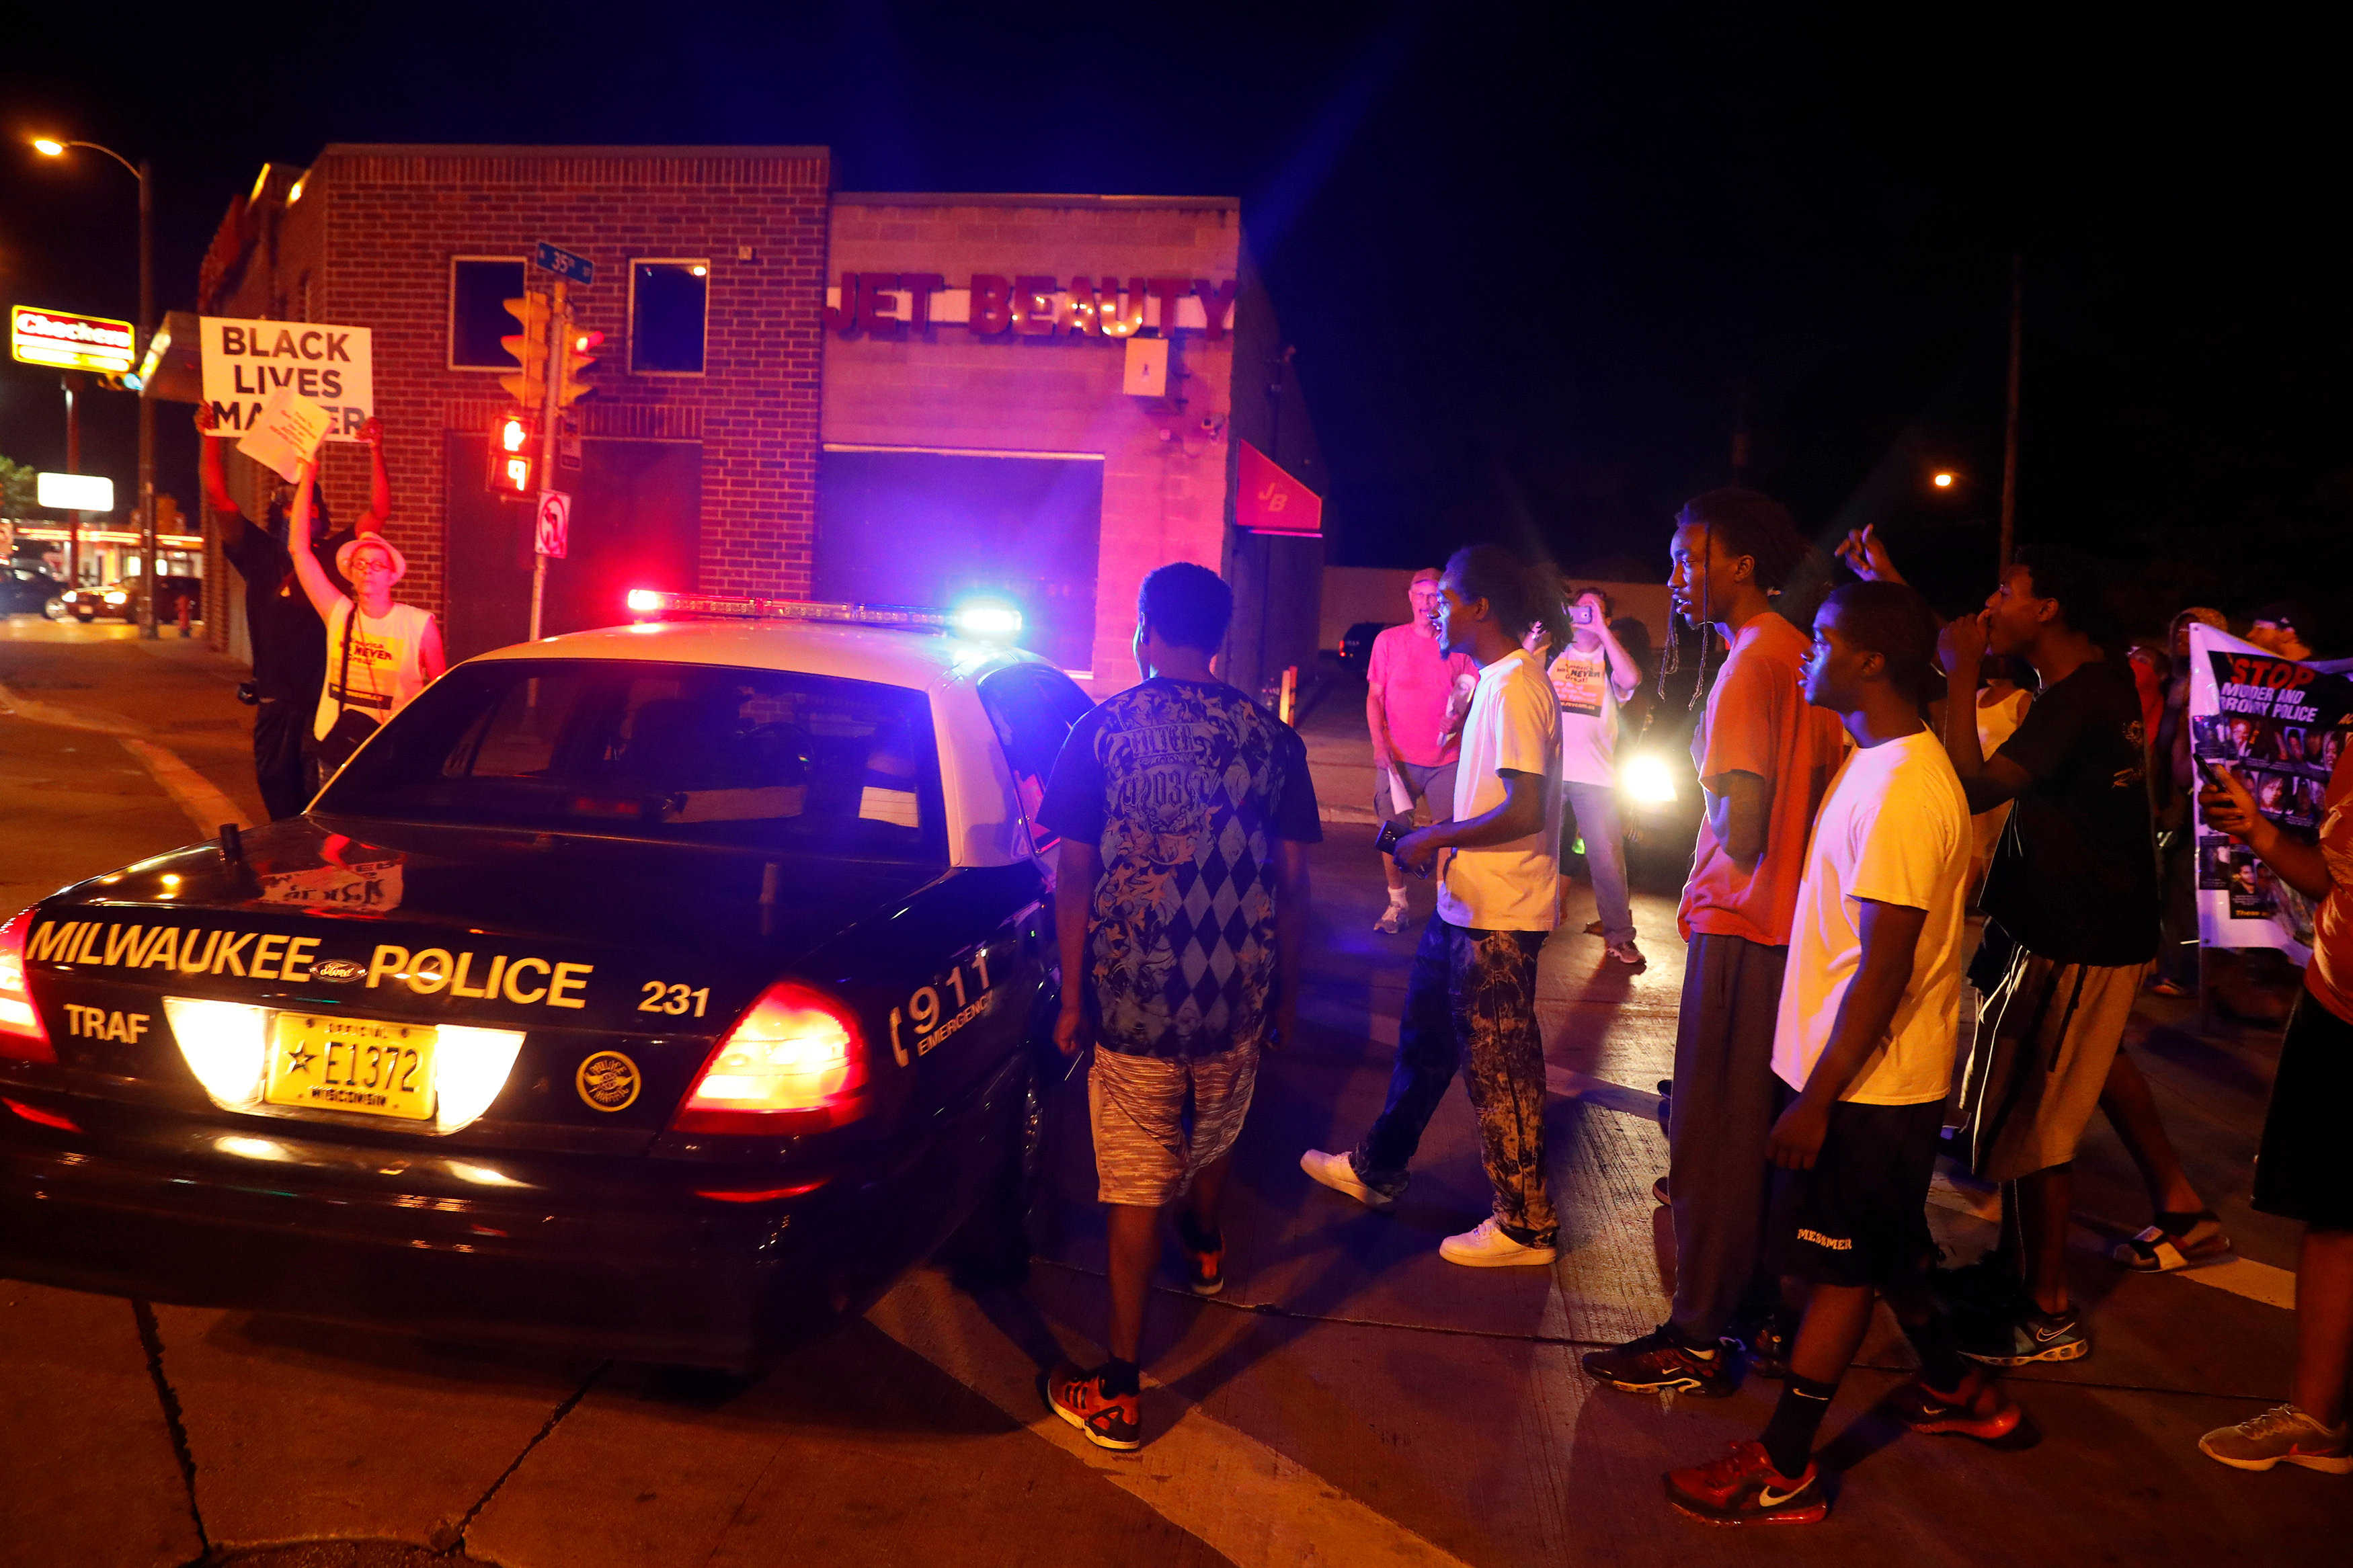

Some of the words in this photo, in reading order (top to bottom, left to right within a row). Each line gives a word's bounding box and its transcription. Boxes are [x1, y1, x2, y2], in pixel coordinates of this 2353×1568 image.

[822, 272, 943, 333] JET
[968, 274, 1238, 339] BEAUTY
[223, 326, 351, 362] BLACK
[234, 364, 342, 398] LIVES
[354, 645, 392, 661] NEVER
[2231, 658, 2315, 691] STOP
[2272, 703, 2319, 723] POLICE
[2276, 688, 2306, 705] AND
[24, 921, 322, 983] MILWAUKEE
[365, 944, 594, 1009] POLICE
[320, 962, 354, 978] Ford
[637, 980, 711, 1019] 231
[909, 947, 990, 1036] 911
[63, 1003, 151, 1045] TRAF
[323, 1041, 420, 1093] E1372
[309, 1085, 389, 1108] WISCONSIN
[1796, 1228, 1852, 1251] MESSMER
